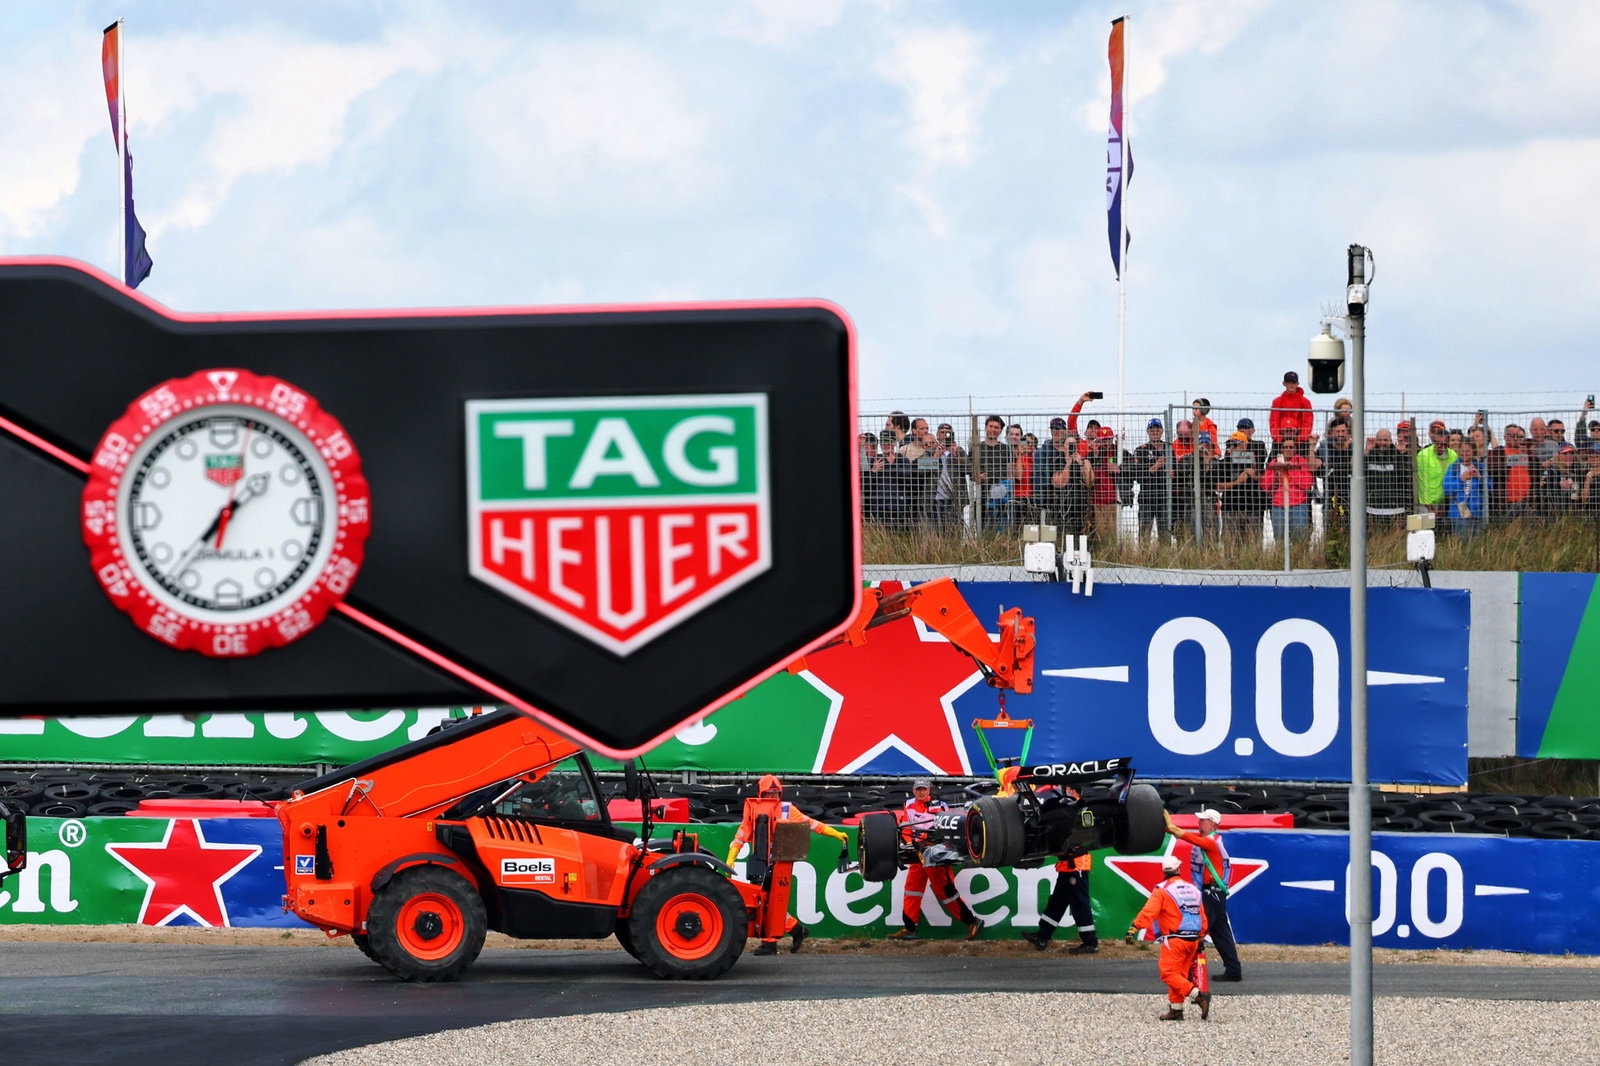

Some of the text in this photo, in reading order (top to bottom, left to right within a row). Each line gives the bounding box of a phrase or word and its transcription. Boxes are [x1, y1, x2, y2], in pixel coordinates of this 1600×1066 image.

[325, 429, 353, 460] 10
[493, 415, 739, 491] TAG
[490, 513, 749, 631] HEUER
[1147, 616, 1339, 757] 0.0
[1033, 759, 1120, 777] ORACLE
[504, 861, 552, 872] Boels
[1345, 850, 1464, 939] 0.0
